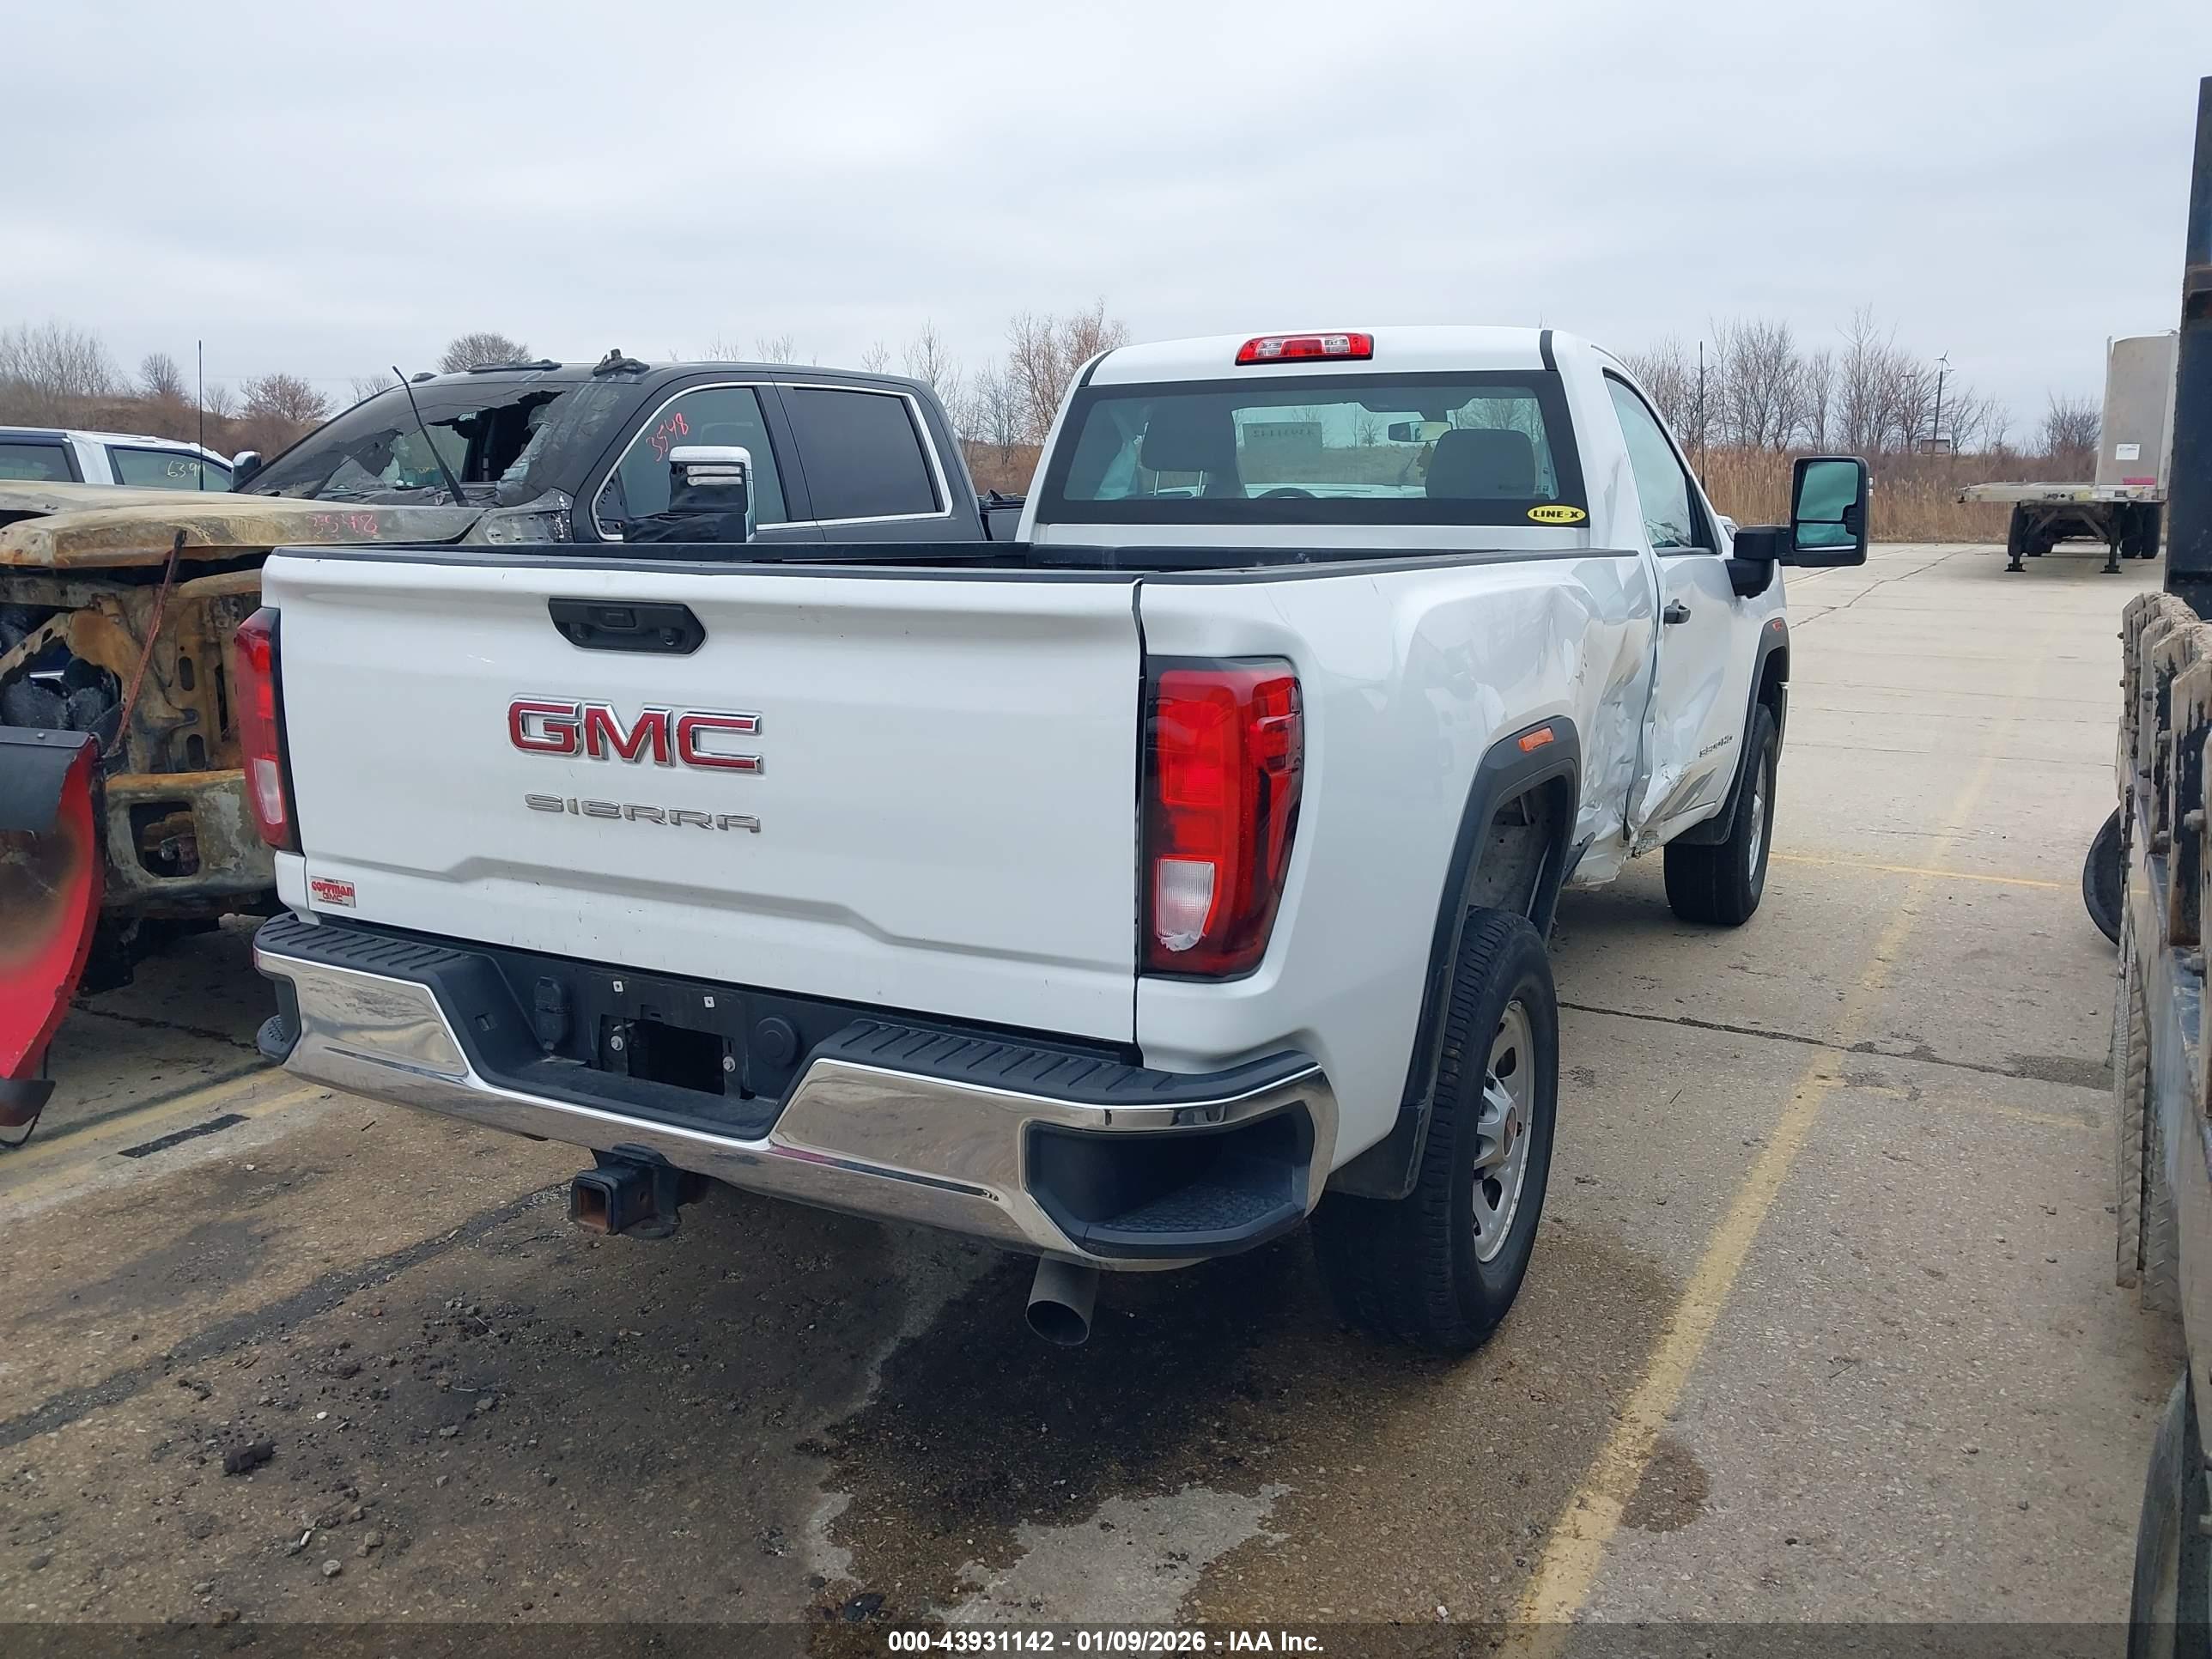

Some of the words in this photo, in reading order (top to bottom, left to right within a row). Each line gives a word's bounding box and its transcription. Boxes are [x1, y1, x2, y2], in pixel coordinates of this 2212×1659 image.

[646, 413, 689, 461] 3548
[1533, 510, 1579, 519] LINE-X
[507, 694, 765, 774] GMC
[525, 793, 762, 833] SIERRA
